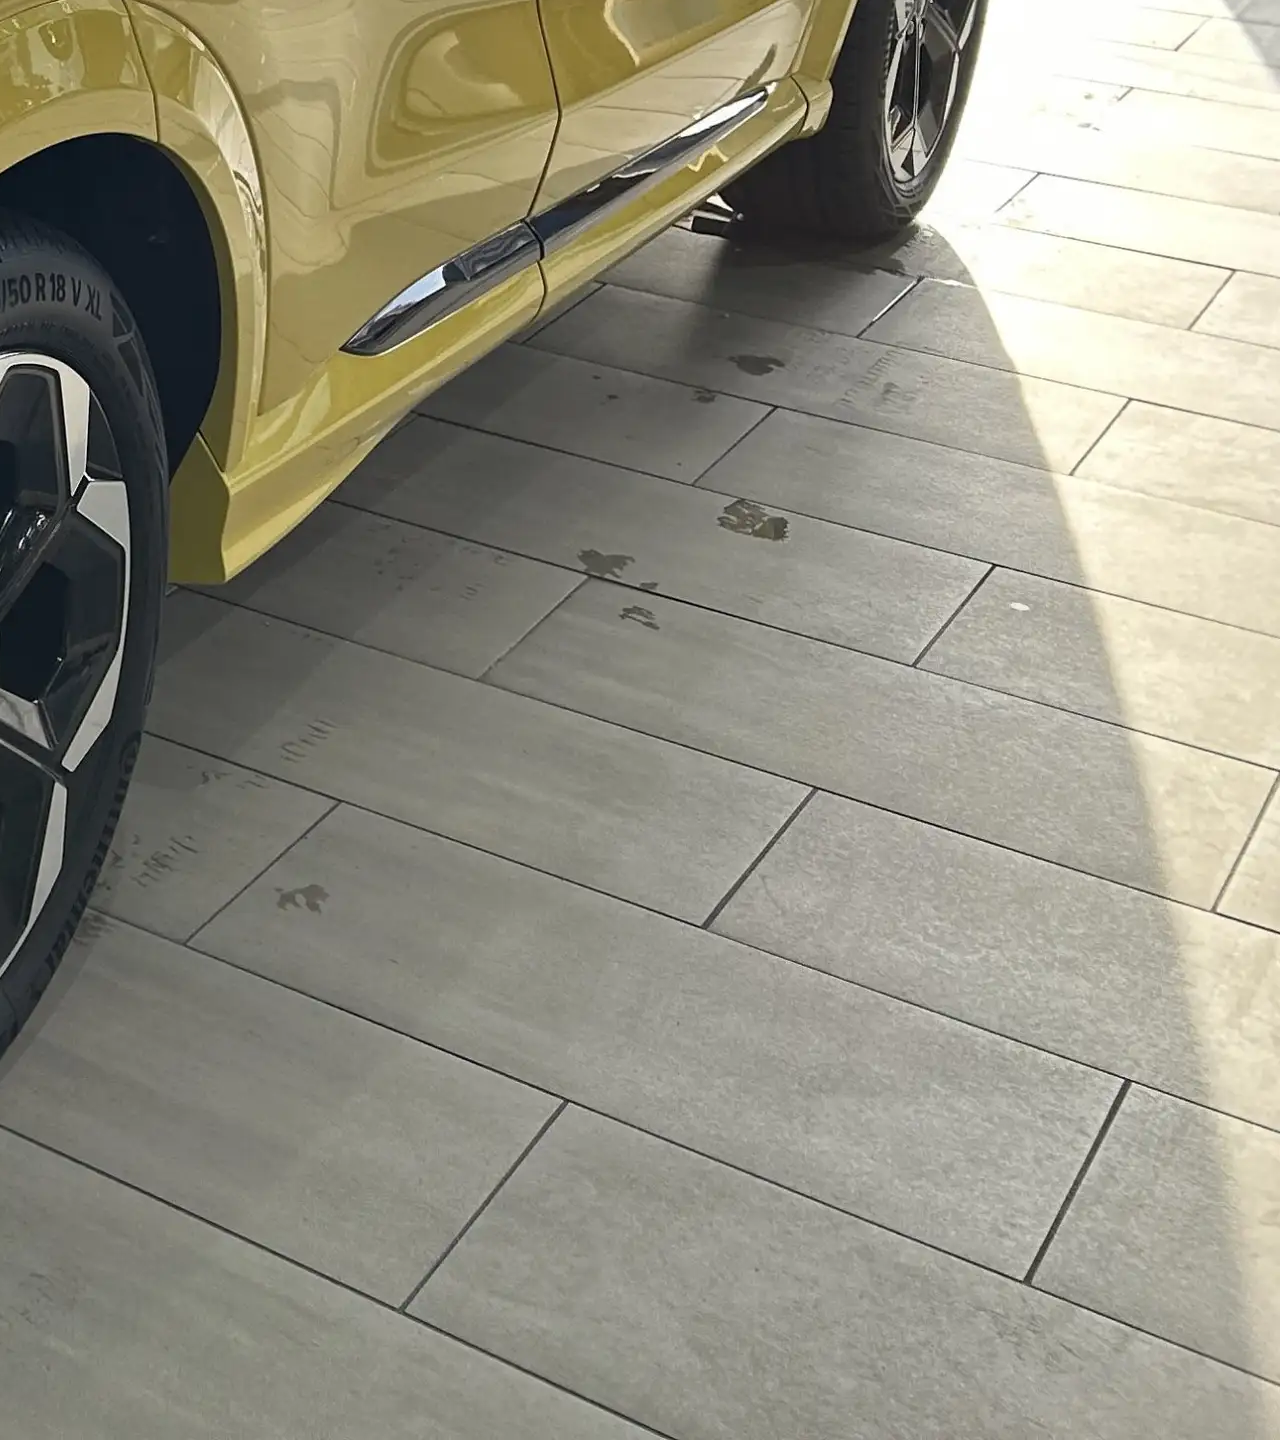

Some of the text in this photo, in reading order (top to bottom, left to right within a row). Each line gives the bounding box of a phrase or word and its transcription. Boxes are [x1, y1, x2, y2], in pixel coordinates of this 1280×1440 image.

[49, 272, 66, 302] 18
[71, 276, 82, 307] V
[85, 284, 102, 321] XL
